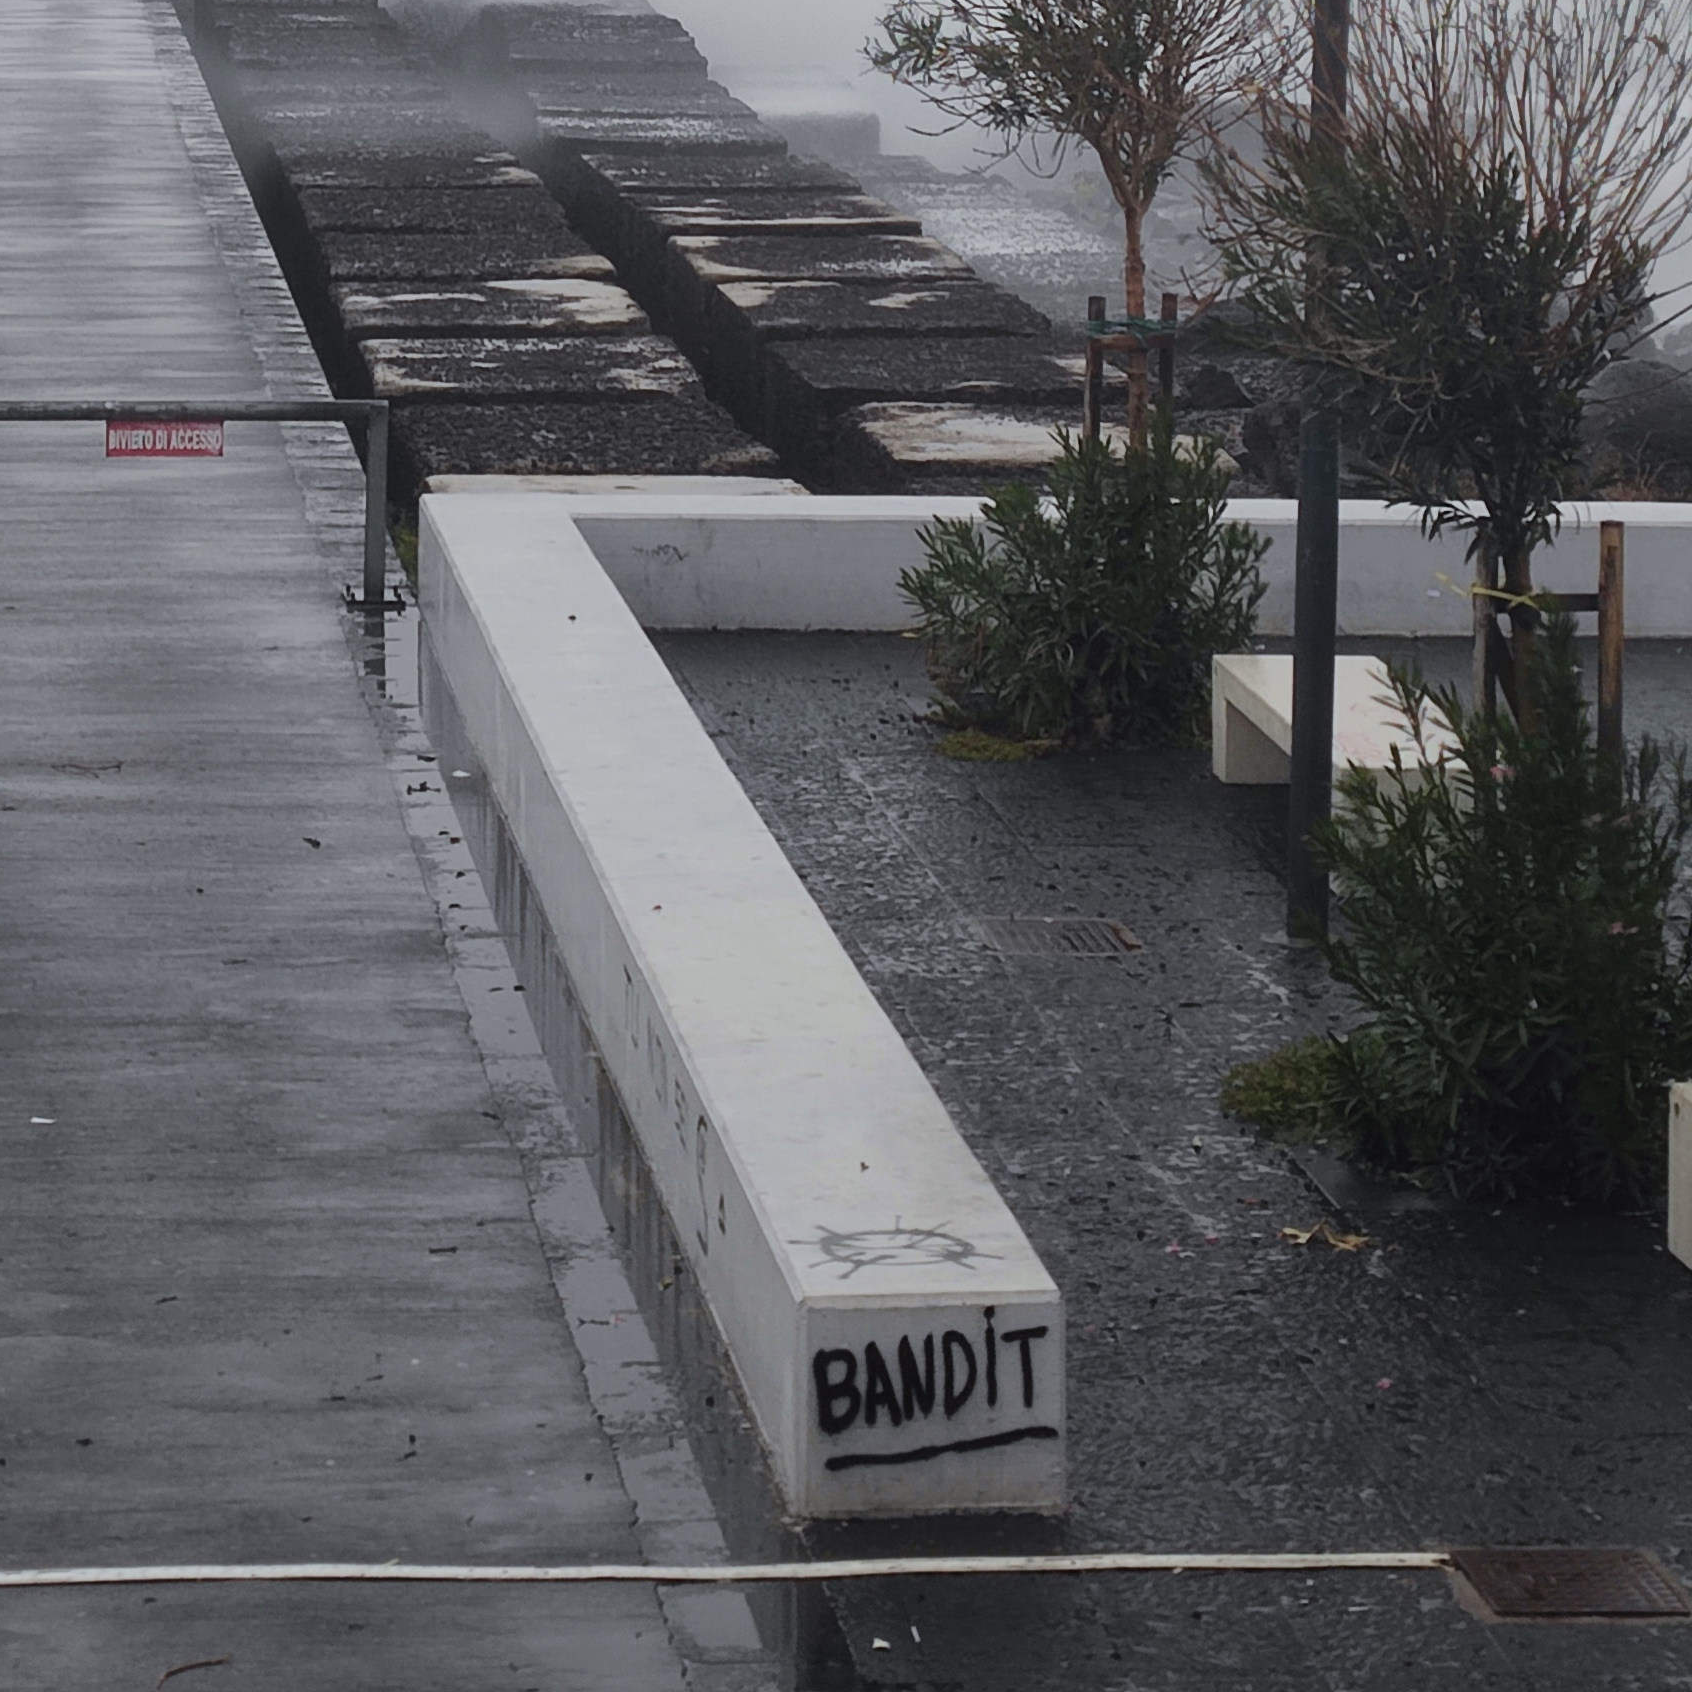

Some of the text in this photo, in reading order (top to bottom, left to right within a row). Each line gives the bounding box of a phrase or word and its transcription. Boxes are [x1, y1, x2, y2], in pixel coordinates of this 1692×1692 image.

[109, 427, 222, 452] DIVIETO DI ACCESSO
[812, 1305, 1049, 1436] BANDIT
